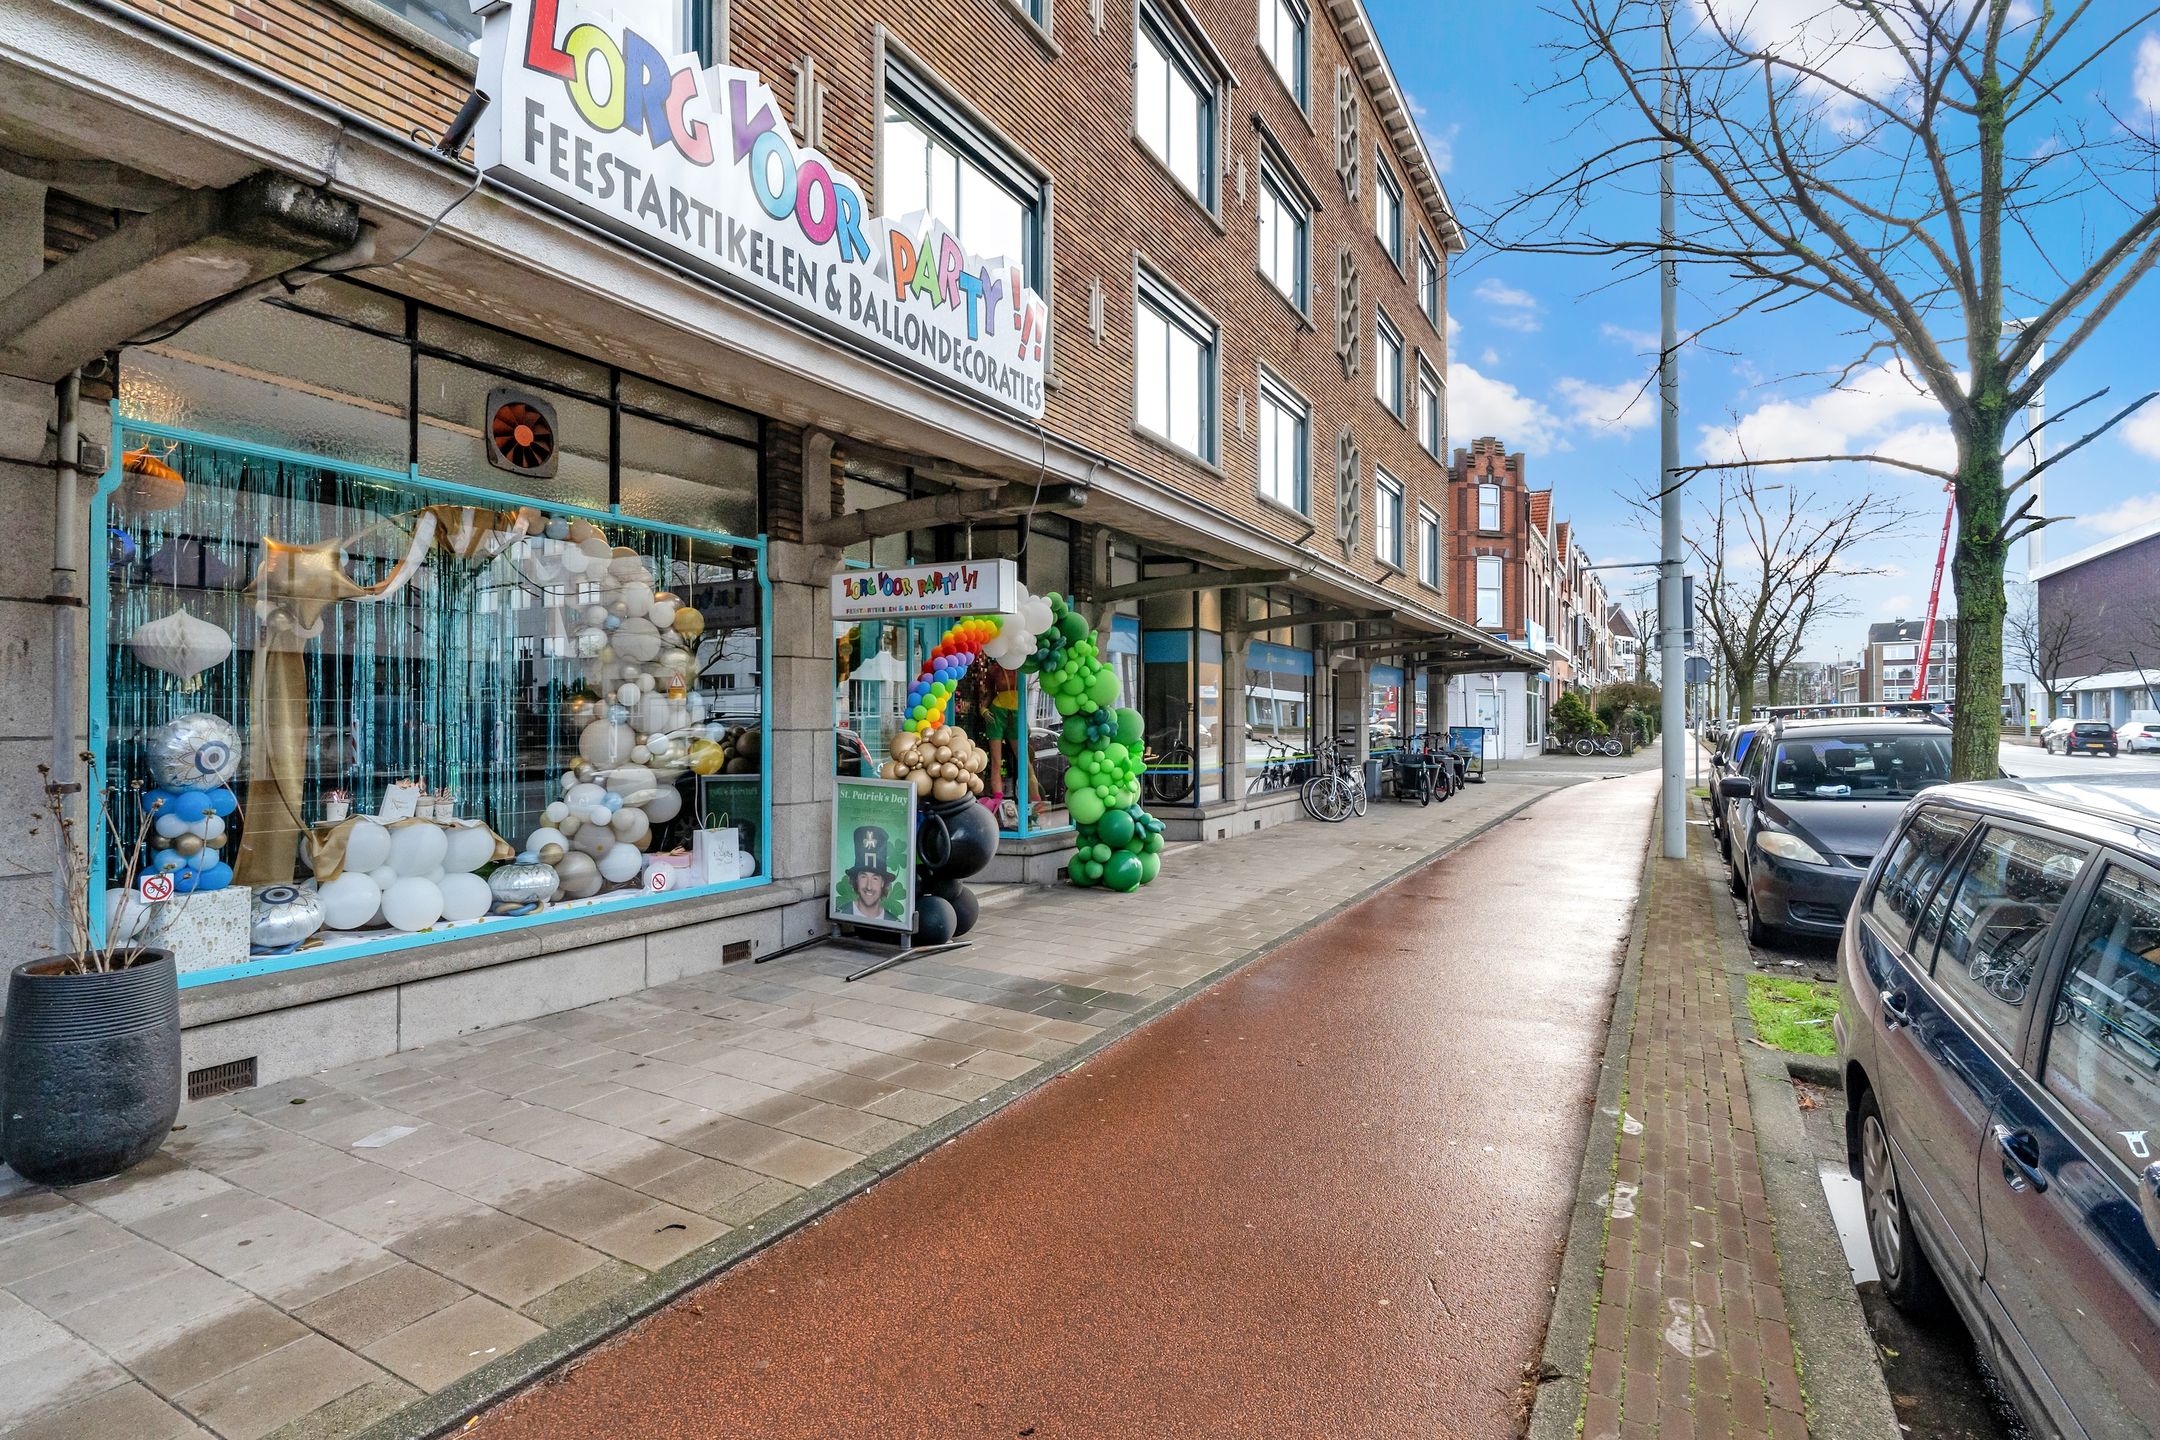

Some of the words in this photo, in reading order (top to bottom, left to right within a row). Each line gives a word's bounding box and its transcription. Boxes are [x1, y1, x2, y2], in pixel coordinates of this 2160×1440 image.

[728, 79, 871, 265] VOOR
[889, 229, 1003, 342] PARTY
[525, 97, 818, 304] FEESTARTIKELEN
[825, 263, 842, 314] &
[849, 273, 1042, 411] BALLONDECORATIES
[843, 577, 877, 600] ZORG
[877, 571, 914, 597] VOOR
[917, 571, 959, 598] PARTY
[846, 606, 897, 614] FEESTARTIKEEN
[905, 601, 972, 611] BALONDECORATIES
[840, 790, 850, 799] St.
[852, 790, 890, 802] Patrick's
[891, 793, 908, 806] Day
